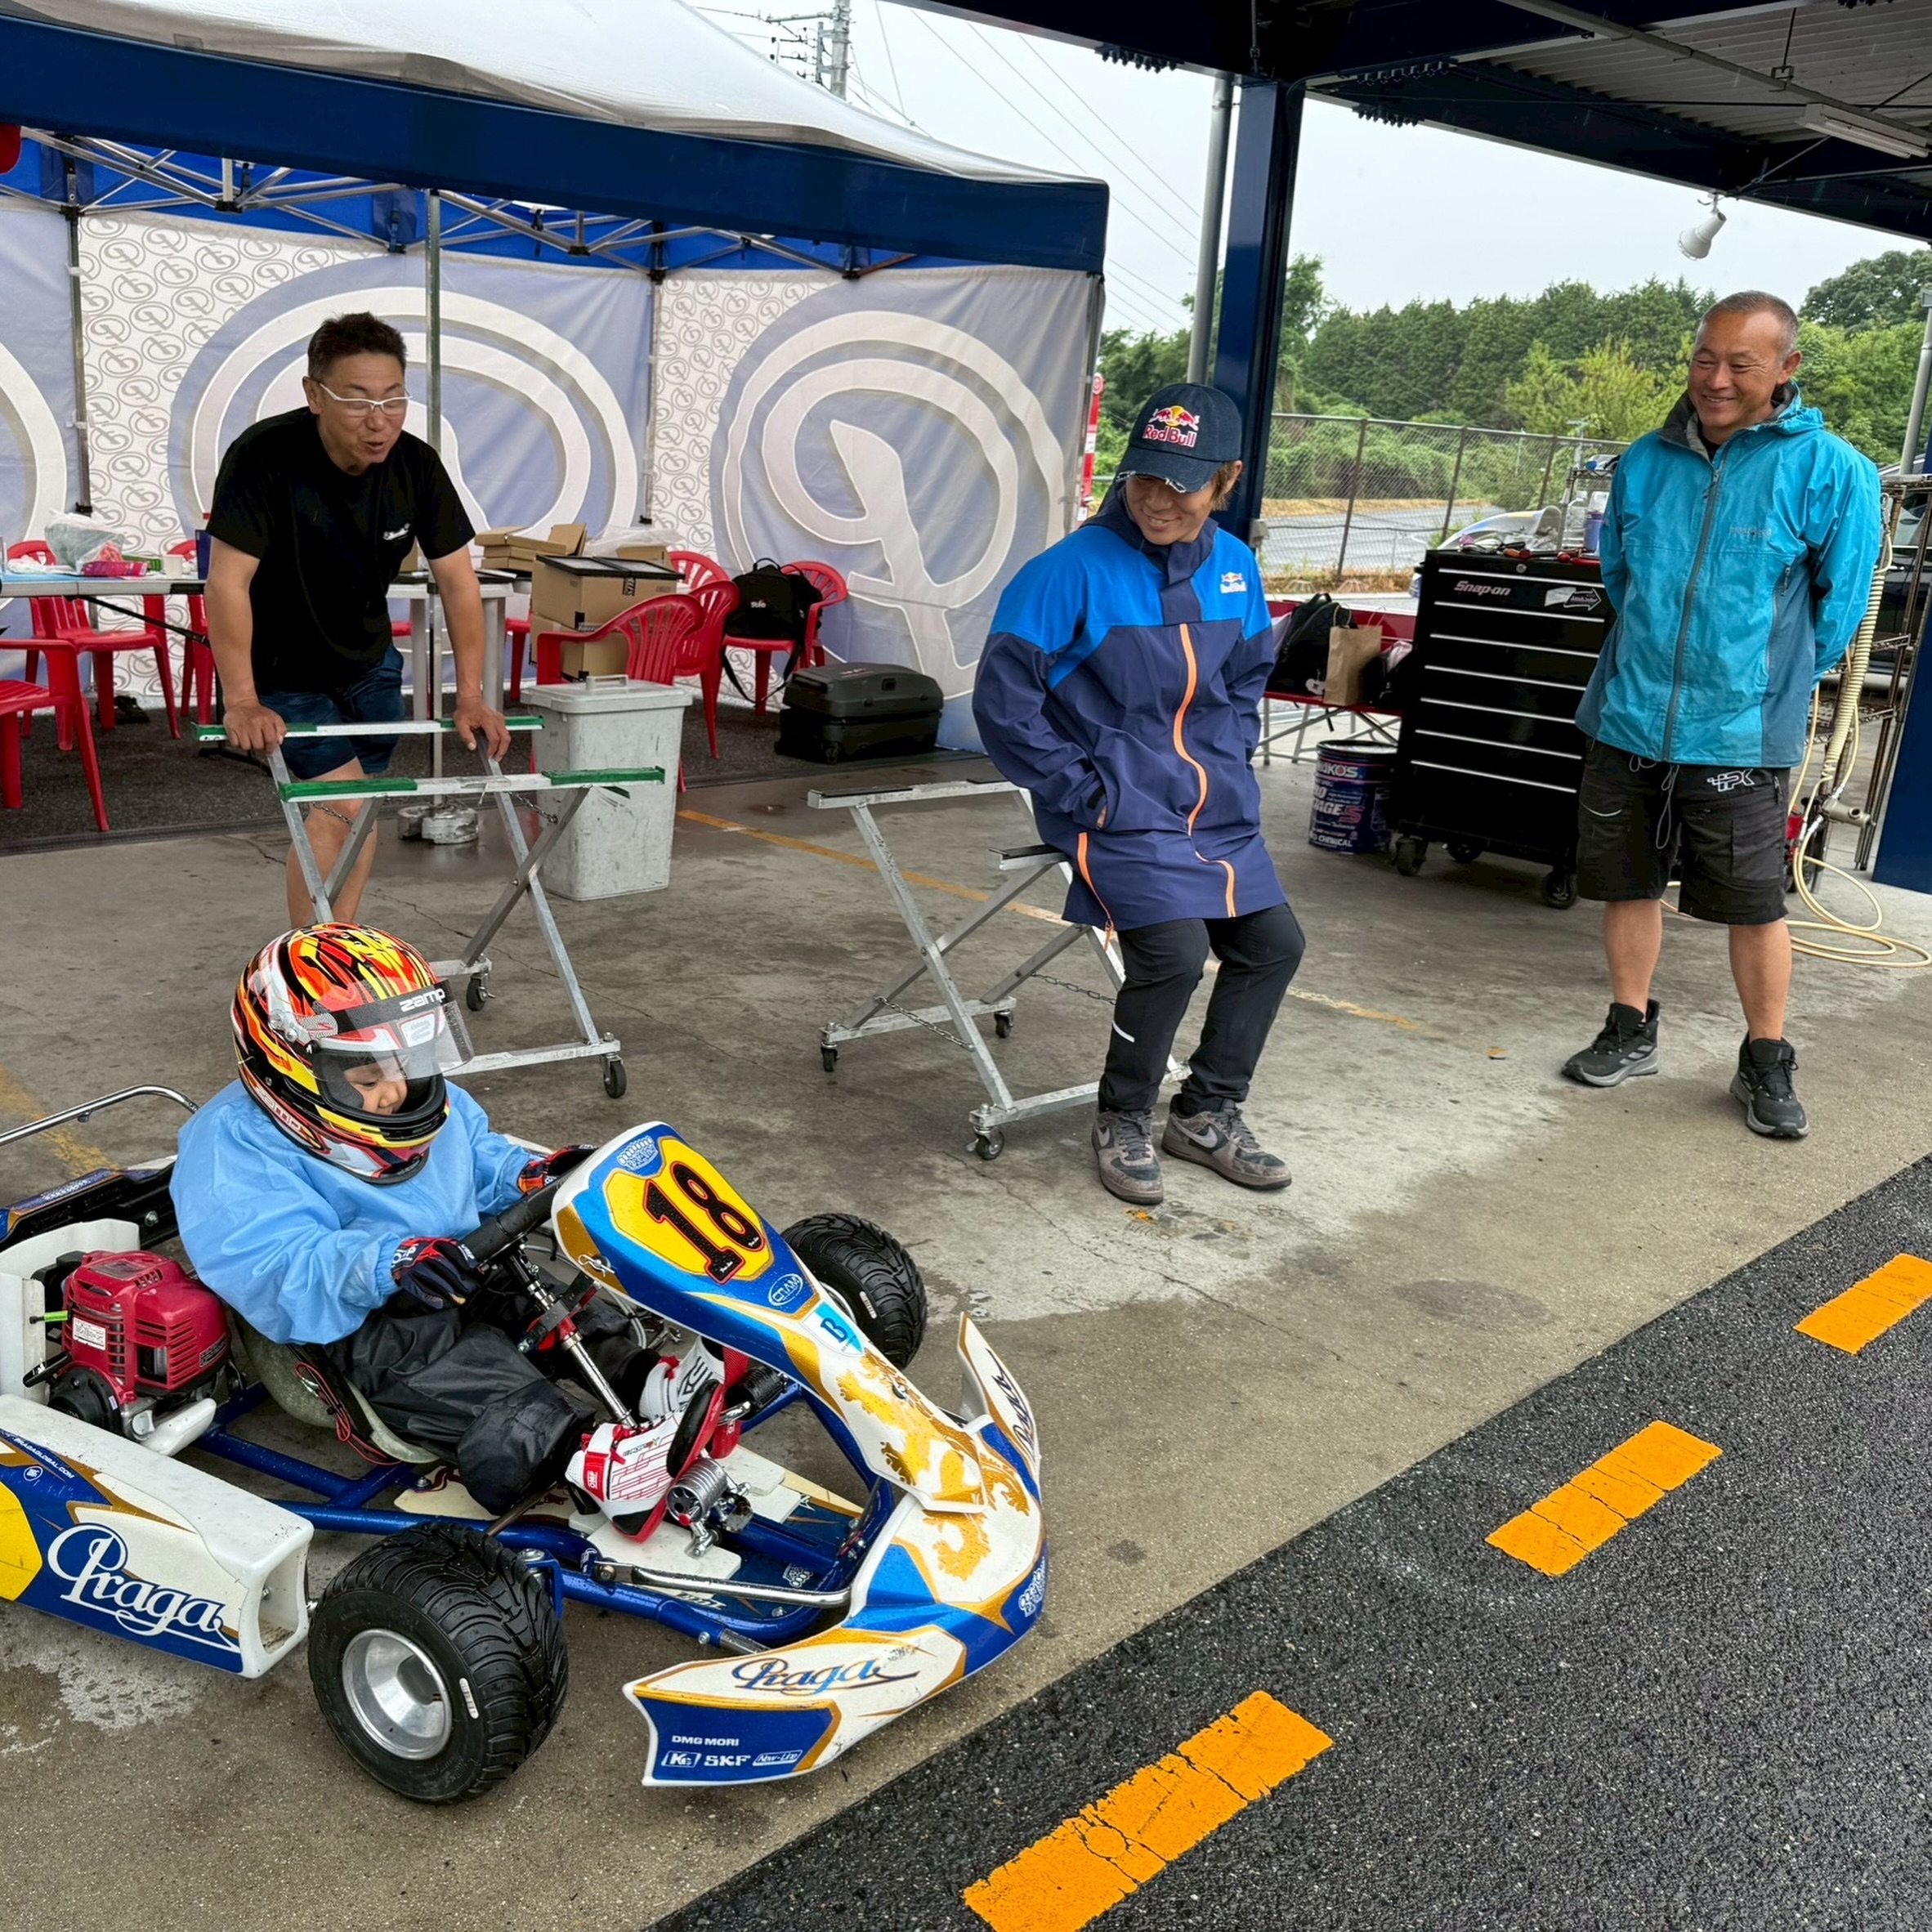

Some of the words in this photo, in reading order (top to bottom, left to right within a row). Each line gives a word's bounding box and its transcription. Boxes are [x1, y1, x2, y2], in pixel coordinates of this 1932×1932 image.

[1143, 424, 1169, 441] Red
[1167, 427, 1197, 448] Bull
[1454, 580, 1510, 596] Snap-on
[399, 988, 446, 1012] zamp
[642, 1161, 765, 1285] 18
[820, 1317, 847, 1344] B
[47, 1523, 241, 1653] Praga
[732, 1657, 921, 1696] Praga
[671, 1735, 703, 1745] DMG
[704, 1737, 740, 1746] MORI
[704, 1755, 750, 1766] SKF
